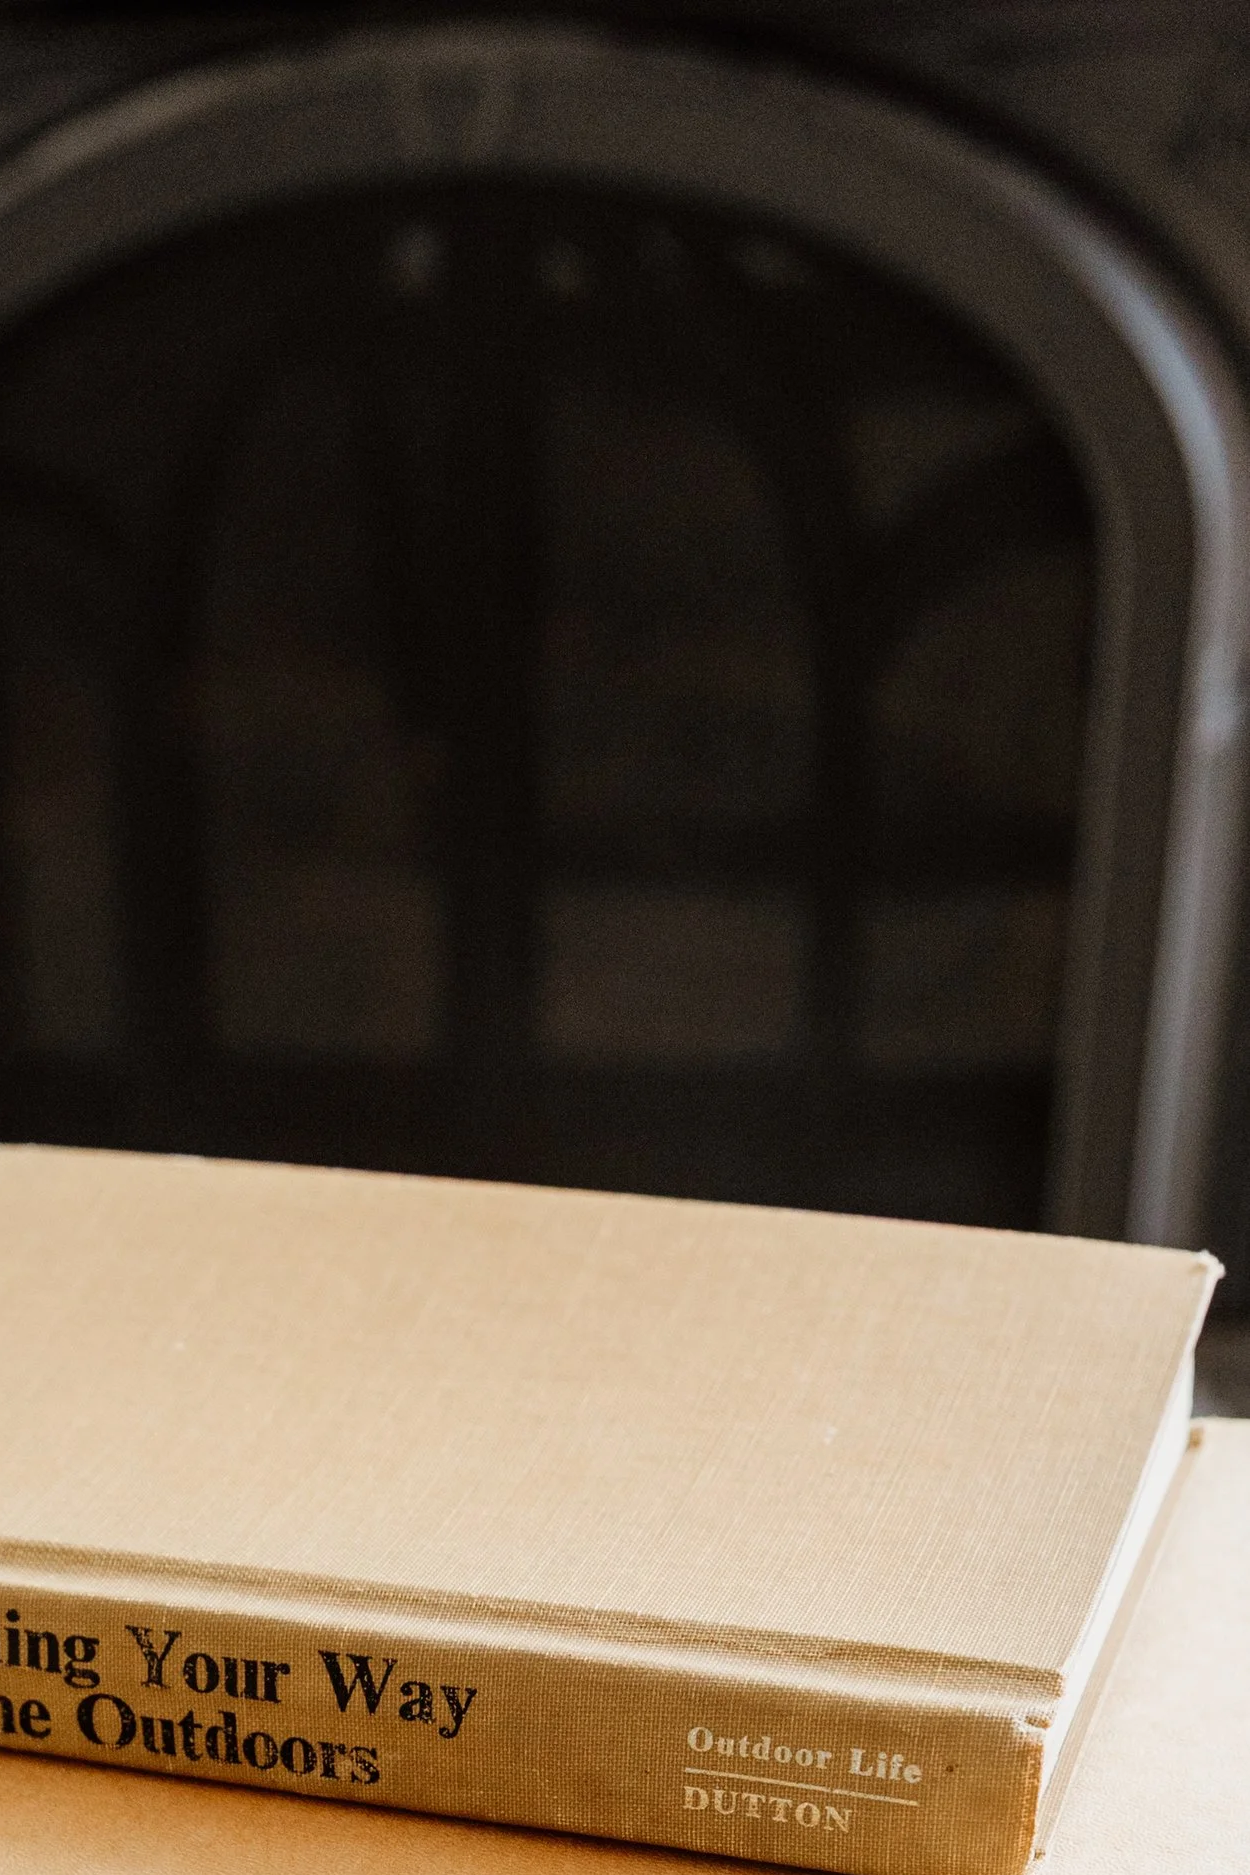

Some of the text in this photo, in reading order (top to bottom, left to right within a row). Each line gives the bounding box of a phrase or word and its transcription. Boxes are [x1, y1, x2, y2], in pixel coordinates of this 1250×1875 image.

[125, 1625, 291, 1703] Your
[319, 1650, 477, 1738] Way
[77, 1693, 381, 1785] Outdoors
[687, 1727, 922, 1783] Outdoor Life
[683, 1786, 853, 1833] DUTTON
